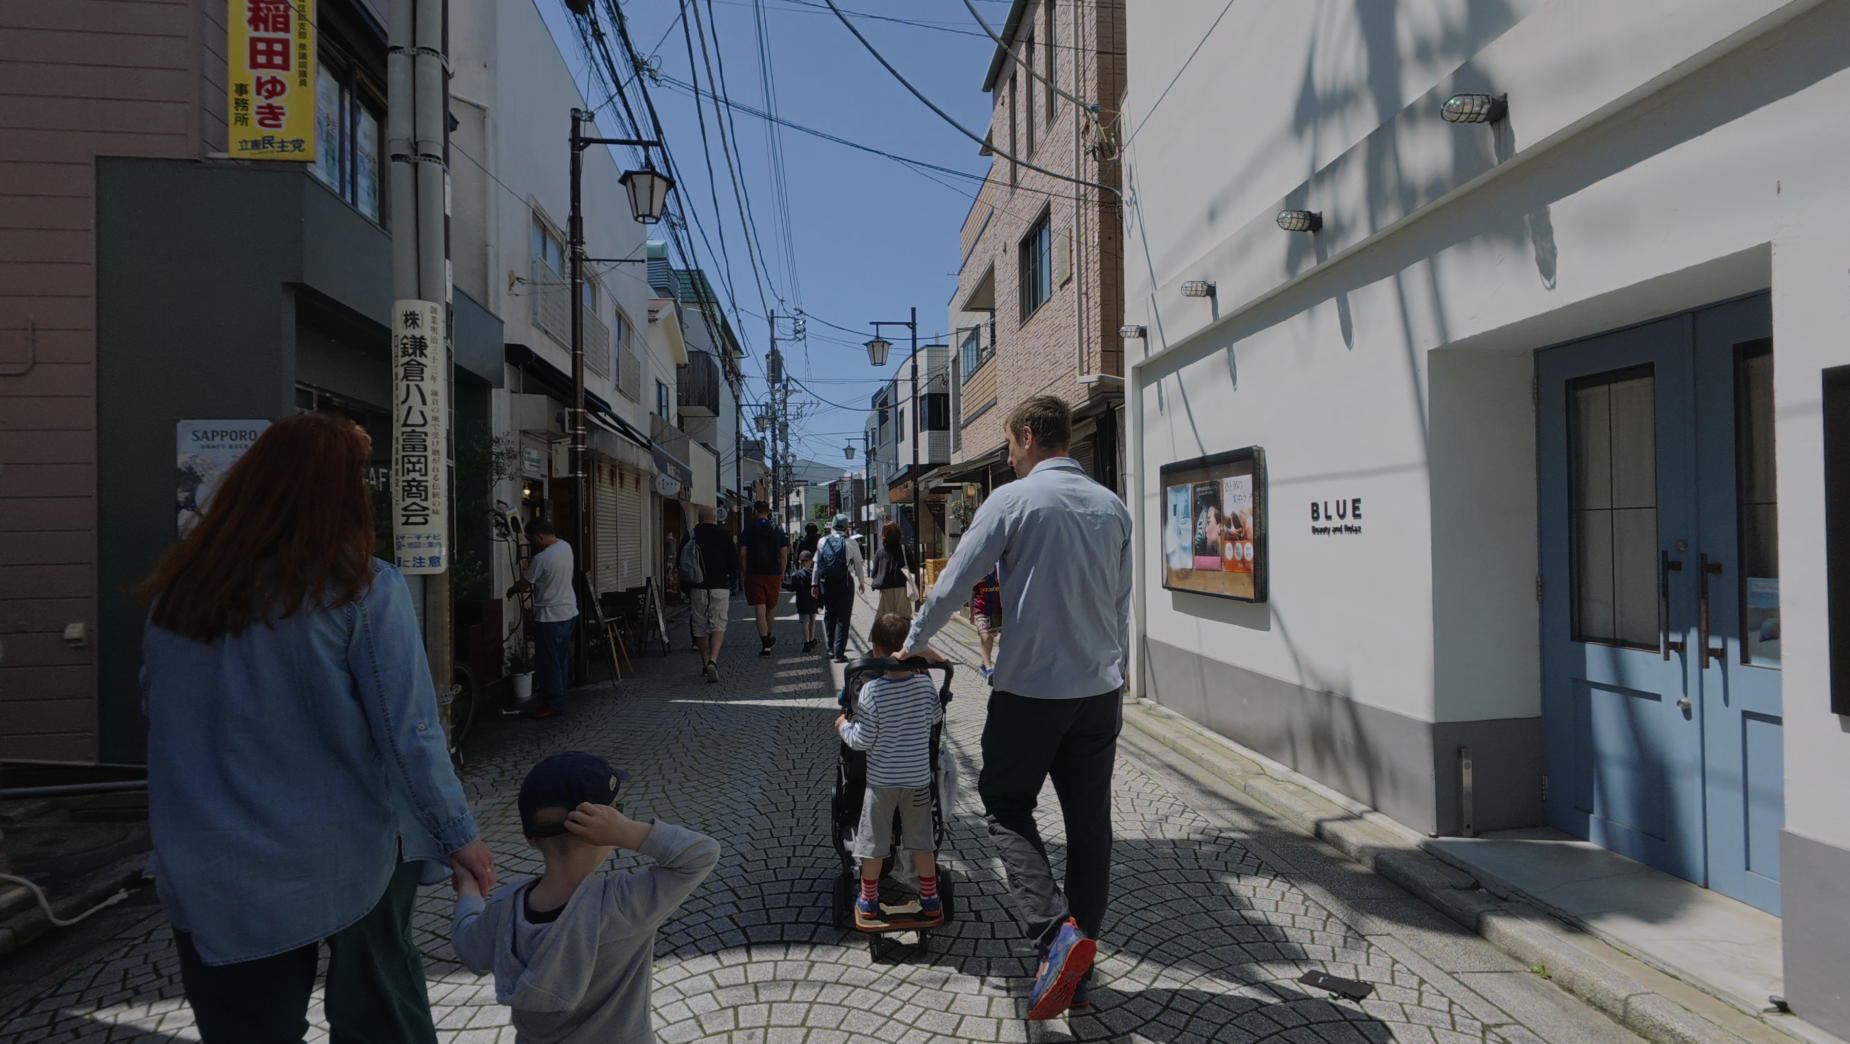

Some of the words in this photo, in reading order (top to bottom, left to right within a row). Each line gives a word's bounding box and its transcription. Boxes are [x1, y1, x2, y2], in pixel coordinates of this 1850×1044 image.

[247, 0, 291, 129] 稲田ゆき
[233, 83, 249, 126] 事務所
[238, 135, 305, 153] 立憲民主党
[191, 429, 258, 442] SAPPORO
[1310, 497, 1362, 522] BLUE
